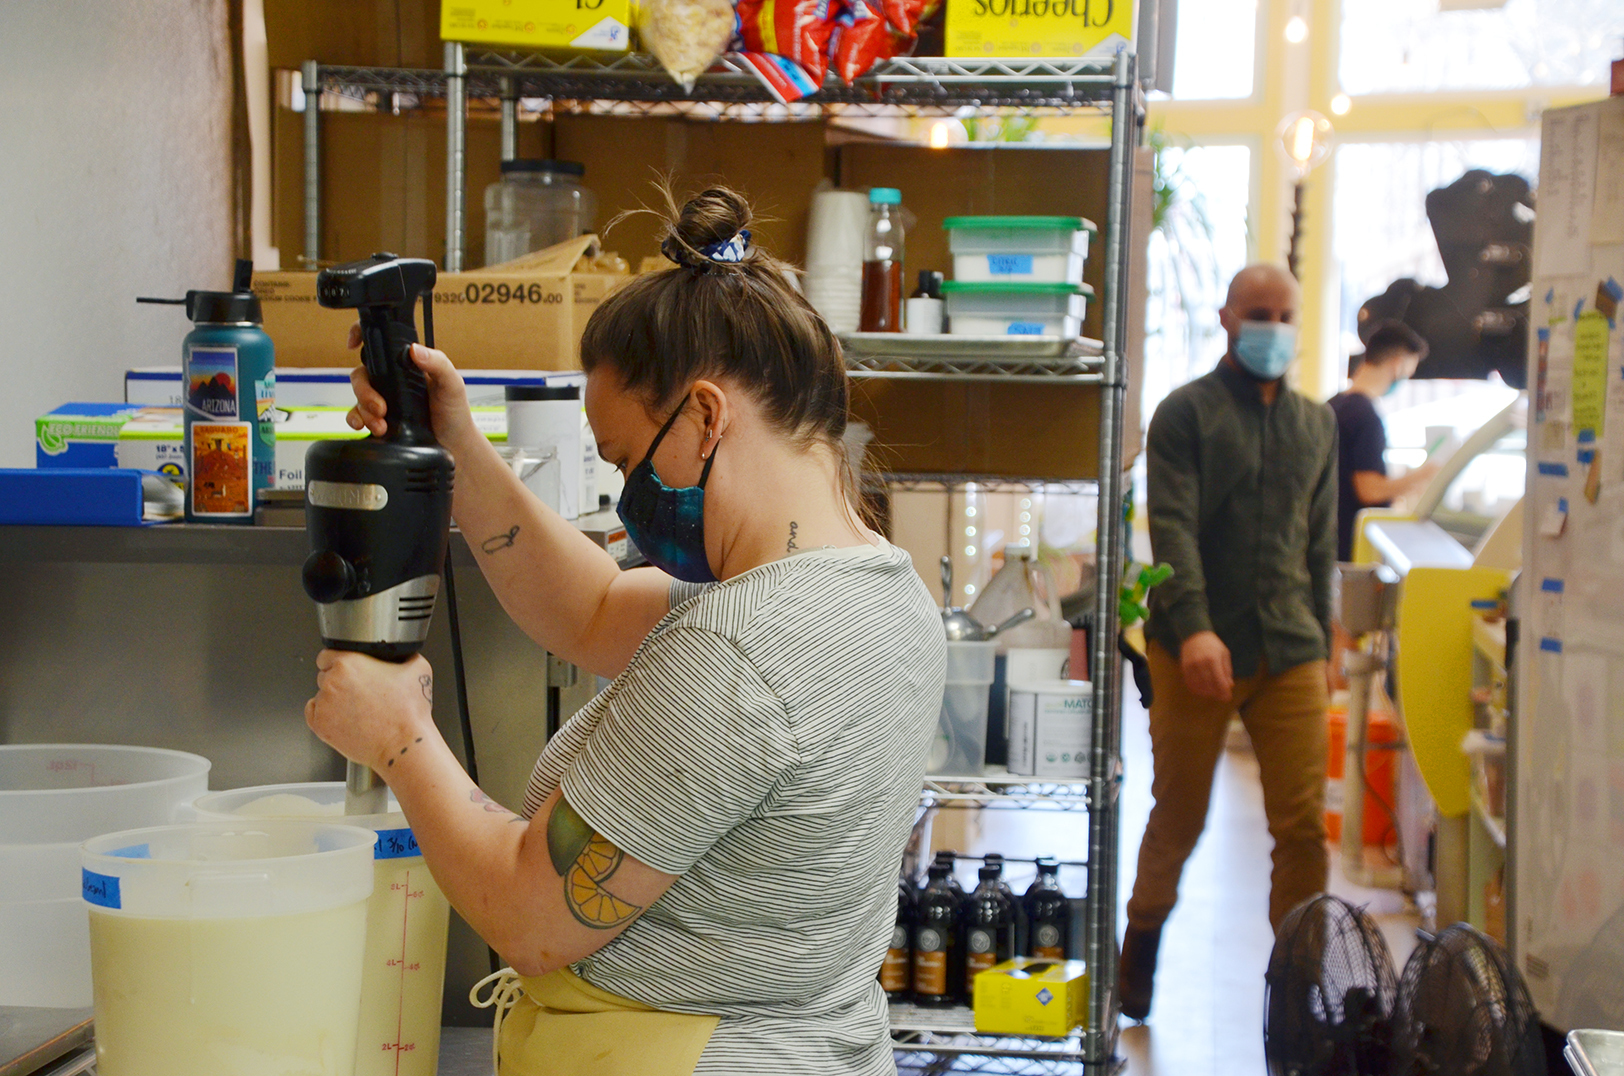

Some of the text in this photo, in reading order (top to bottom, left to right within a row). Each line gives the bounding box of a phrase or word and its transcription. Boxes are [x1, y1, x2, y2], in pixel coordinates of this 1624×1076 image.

[202, 399, 237, 414] ARIZONA
[50, 424, 73, 436] ECO
[279, 469, 302, 480] Foil
[786, 521, 799, 553] and
